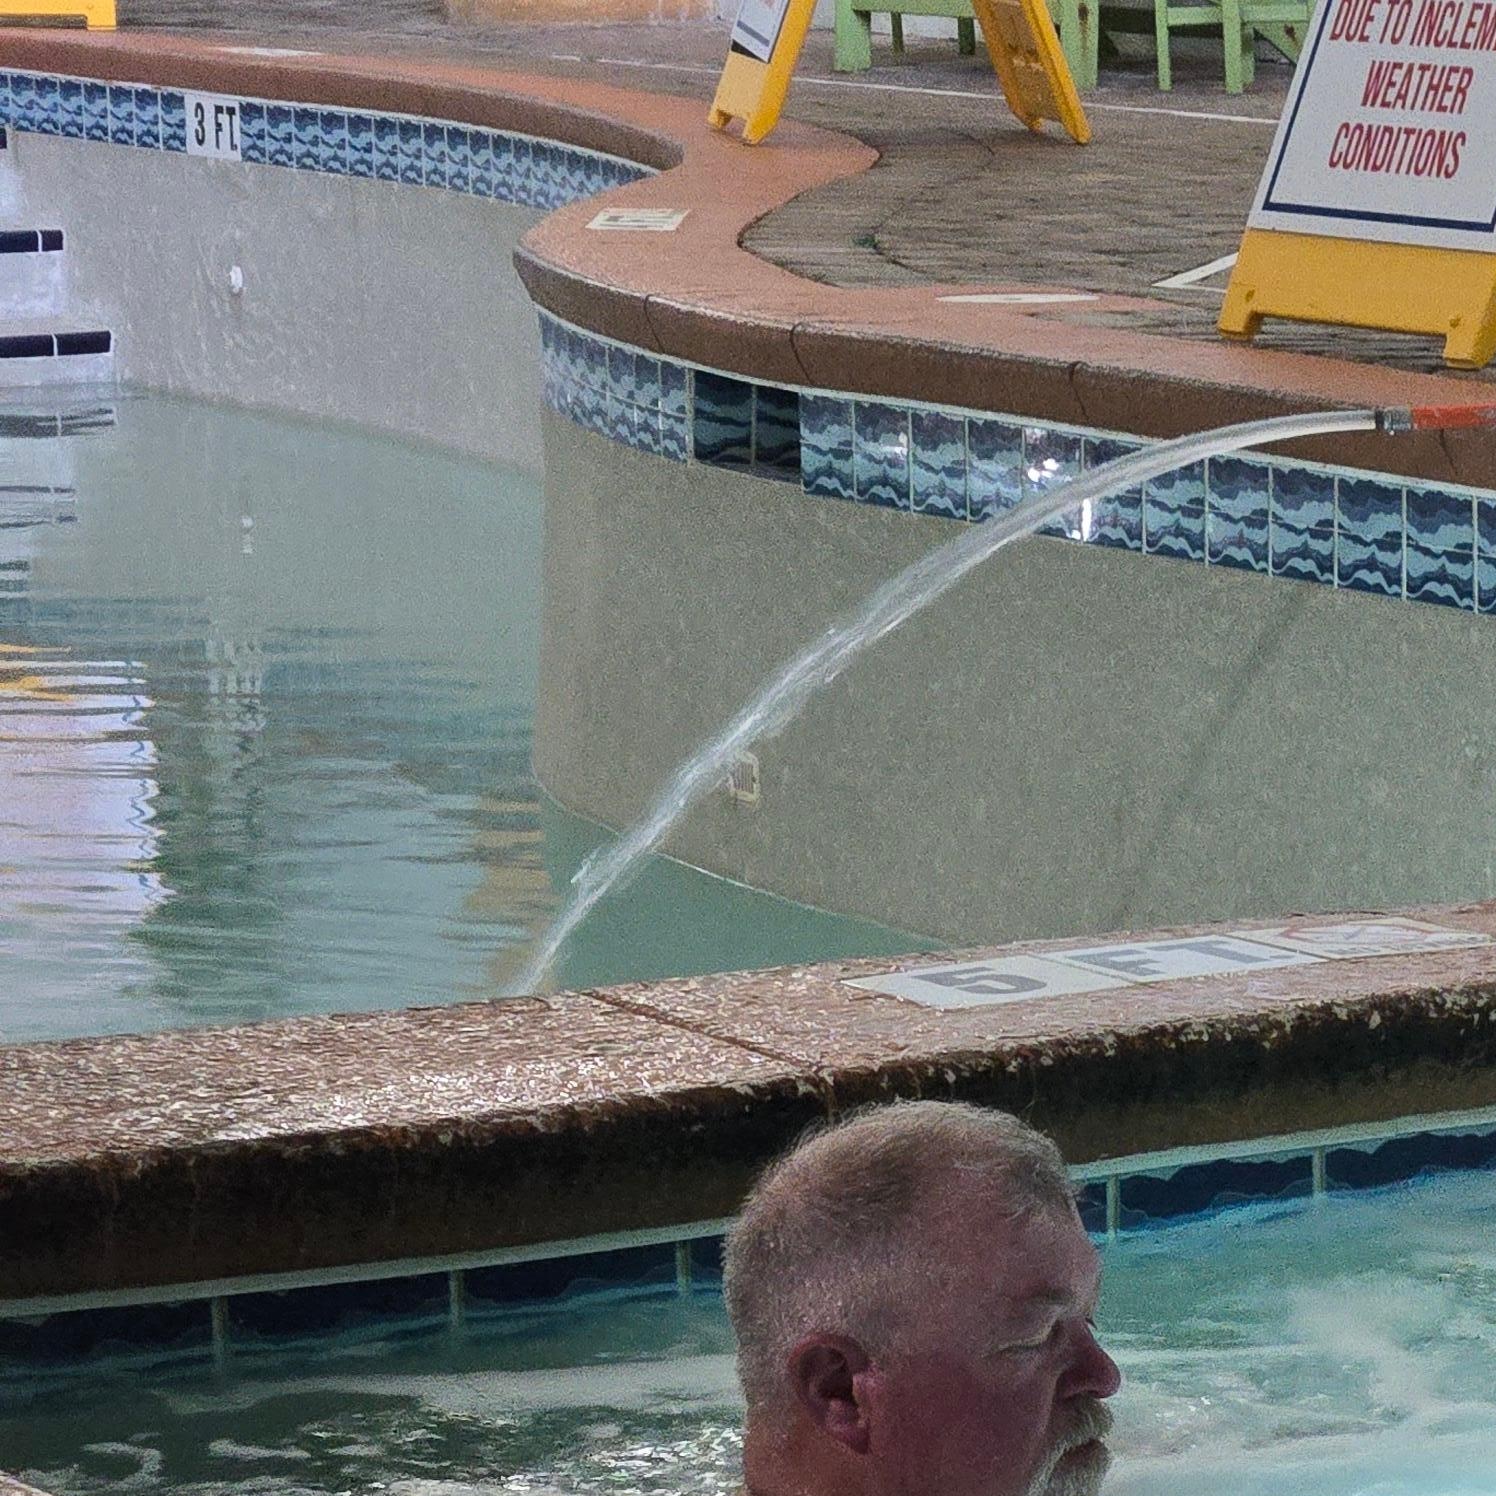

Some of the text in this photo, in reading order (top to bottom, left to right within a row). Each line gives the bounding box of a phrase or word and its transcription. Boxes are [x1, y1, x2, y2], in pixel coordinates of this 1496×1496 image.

[1329, 0, 1382, 42] DUE
[1379, 0, 1413, 45] TO
[1360, 60, 1474, 114] WEATHER
[194, 101, 206, 147] 3
[1328, 122, 1467, 179] CONDITIONS
[911, 966, 1048, 995] 5
[1065, 940, 1297, 976] FT.
